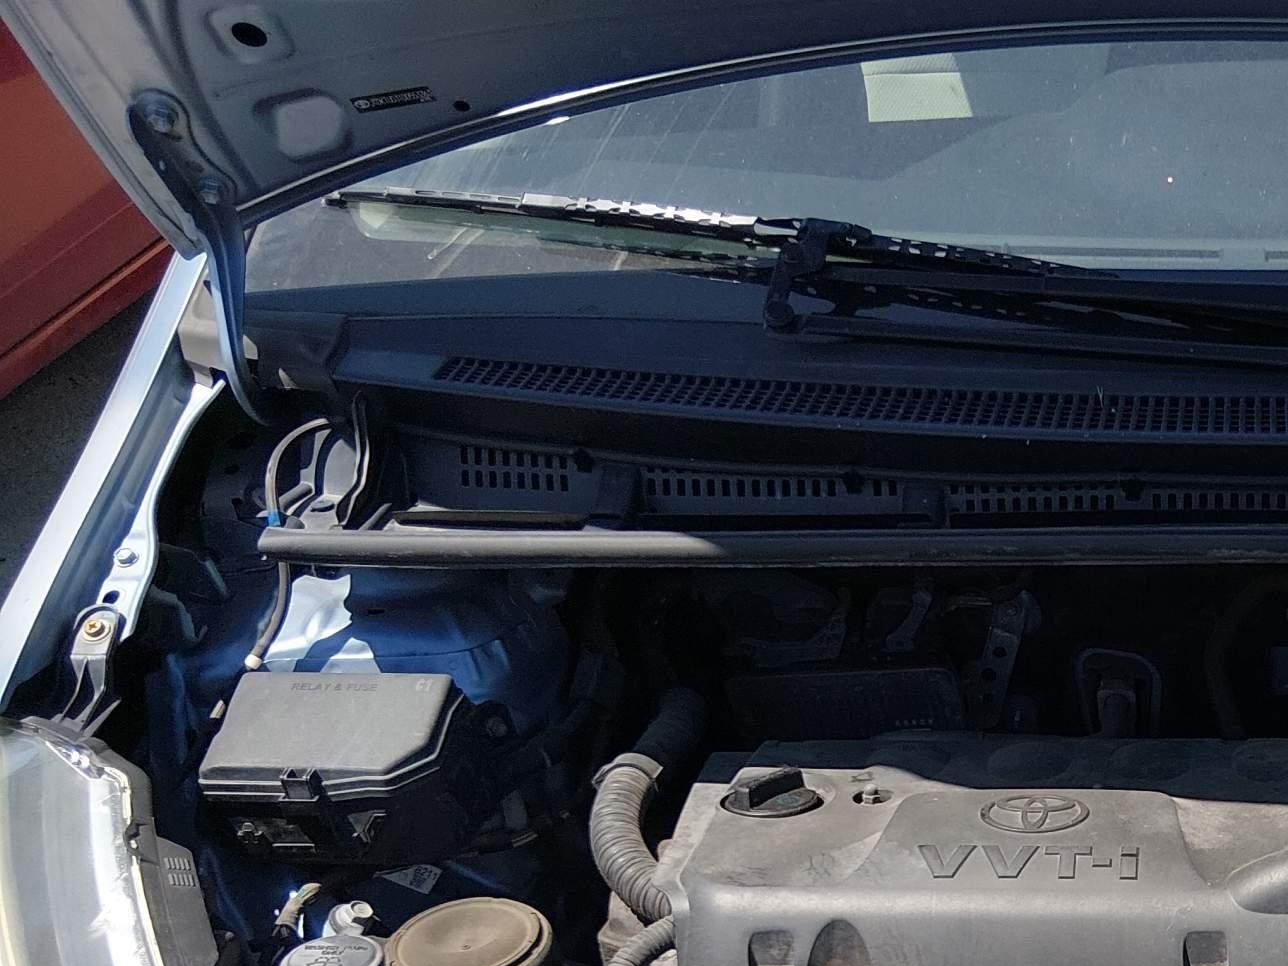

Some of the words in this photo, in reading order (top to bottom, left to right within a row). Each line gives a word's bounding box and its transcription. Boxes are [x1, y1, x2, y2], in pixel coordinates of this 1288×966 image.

[290, 682, 331, 691] RELAY
[334, 682, 341, 691] &
[346, 682, 379, 692] FUSE
[917, 845, 1140, 880] VVT-i
